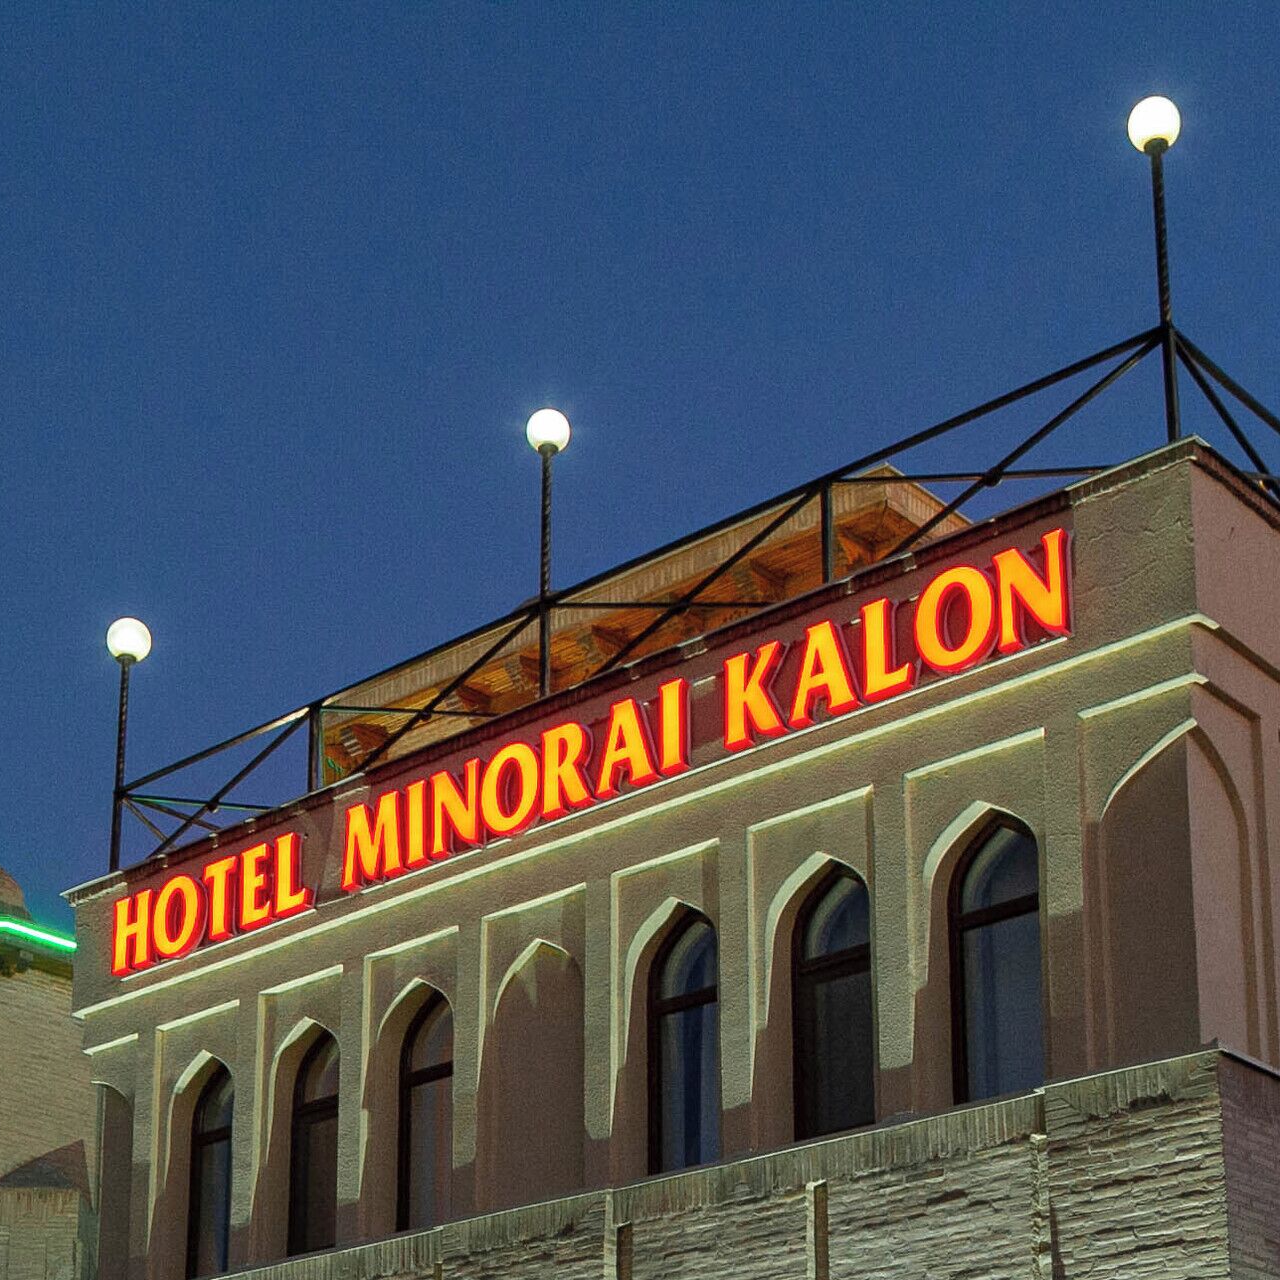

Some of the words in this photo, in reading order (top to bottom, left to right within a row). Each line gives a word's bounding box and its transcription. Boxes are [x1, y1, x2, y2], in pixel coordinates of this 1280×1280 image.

[111, 832, 315, 977] HOTEL
[342, 677, 691, 891] MINORAI
[724, 528, 1072, 752] KALON
